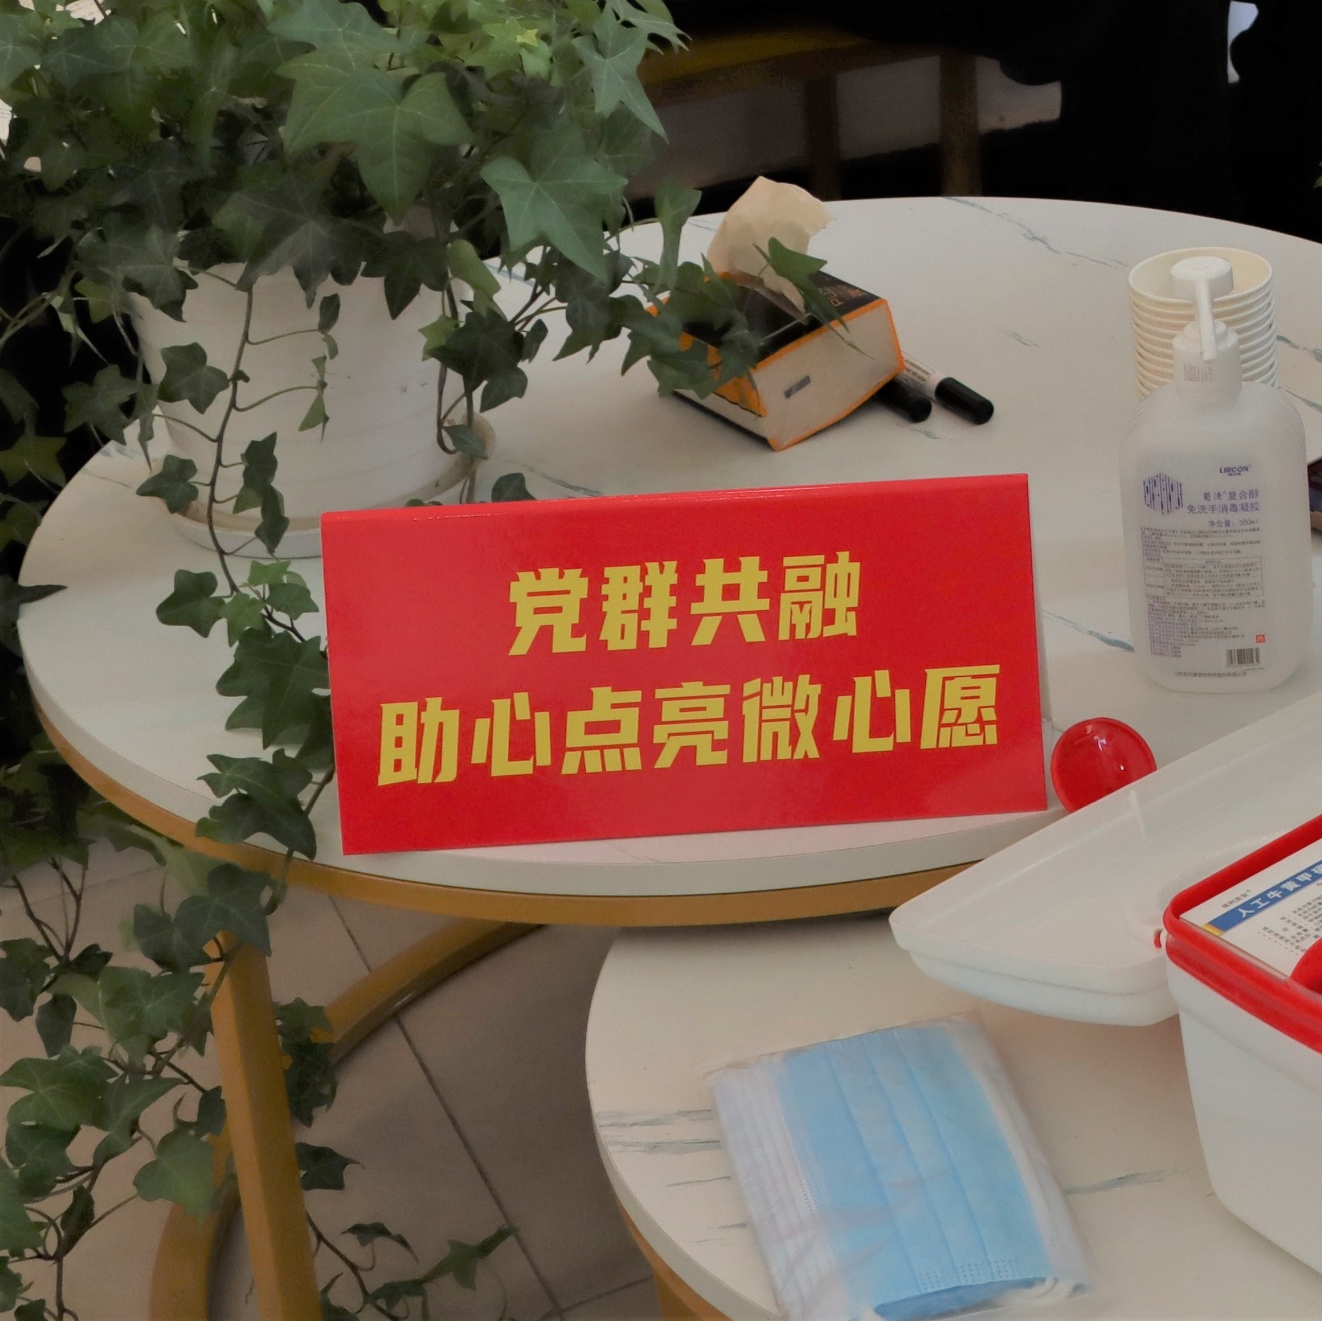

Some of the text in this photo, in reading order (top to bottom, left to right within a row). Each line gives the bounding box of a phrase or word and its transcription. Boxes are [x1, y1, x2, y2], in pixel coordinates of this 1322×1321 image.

[1219, 466, 1250, 475] LIRCON
[1187, 502, 1260, 516] 免洗手消毒凝胶
[509, 551, 861, 656] 党群共融
[378, 664, 1001, 786] 助心点亮微心愿
